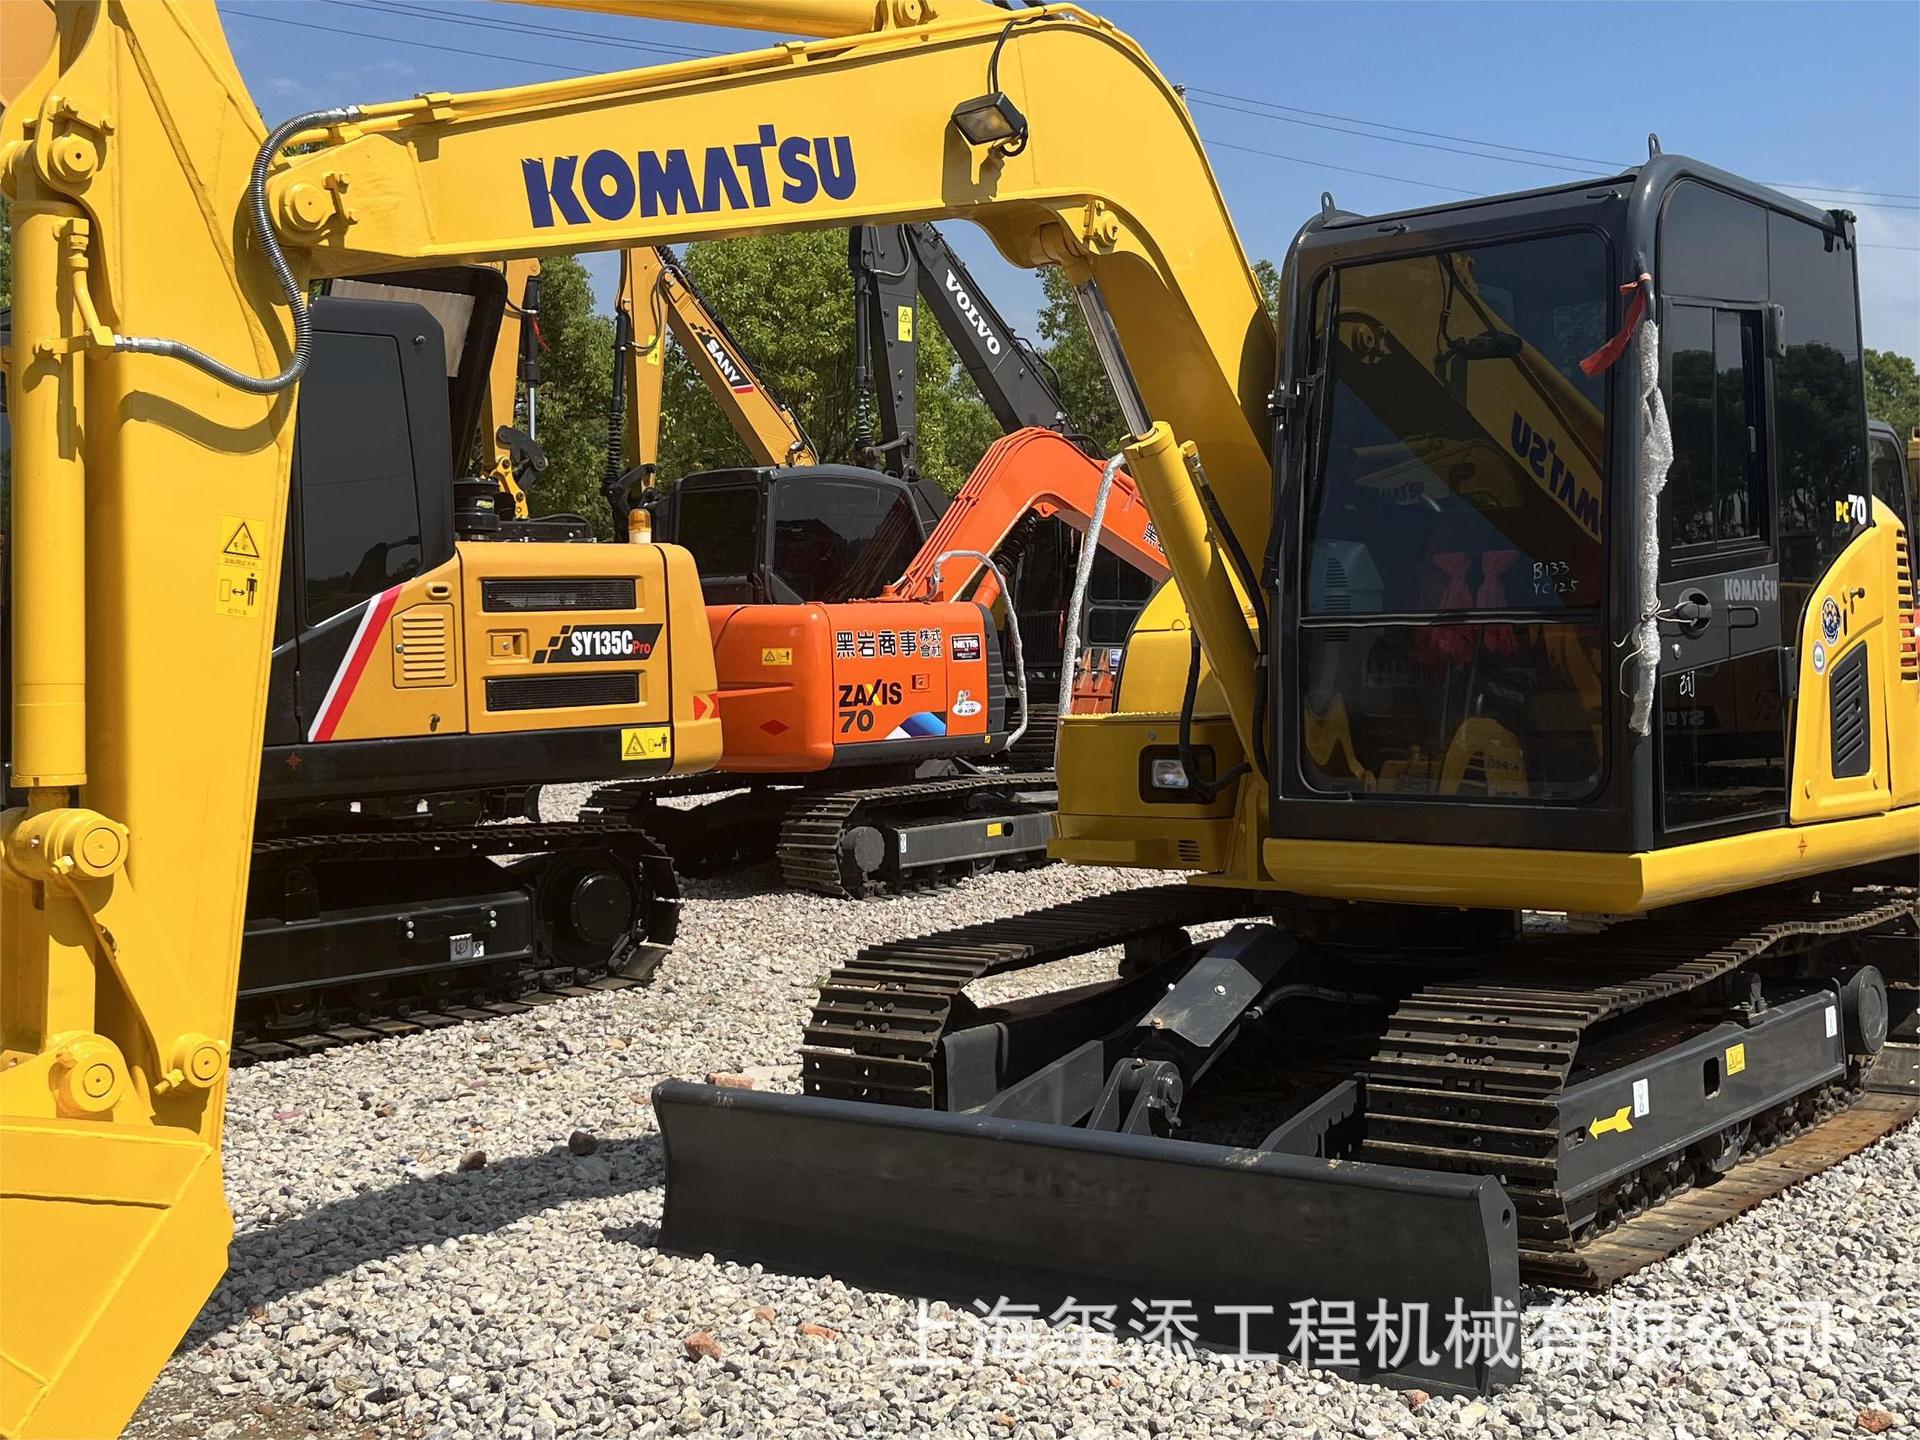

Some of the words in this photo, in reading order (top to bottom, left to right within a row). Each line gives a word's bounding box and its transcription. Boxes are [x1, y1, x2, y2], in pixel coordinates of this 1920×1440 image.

[521, 124, 856, 228] KOMATSU
[945, 268, 1001, 355] VOLVO
[706, 338, 741, 383] SANY
[1724, 574, 1778, 602] KOMATSU
[838, 679, 902, 708] ZAXIS
[838, 709, 874, 733] 70
